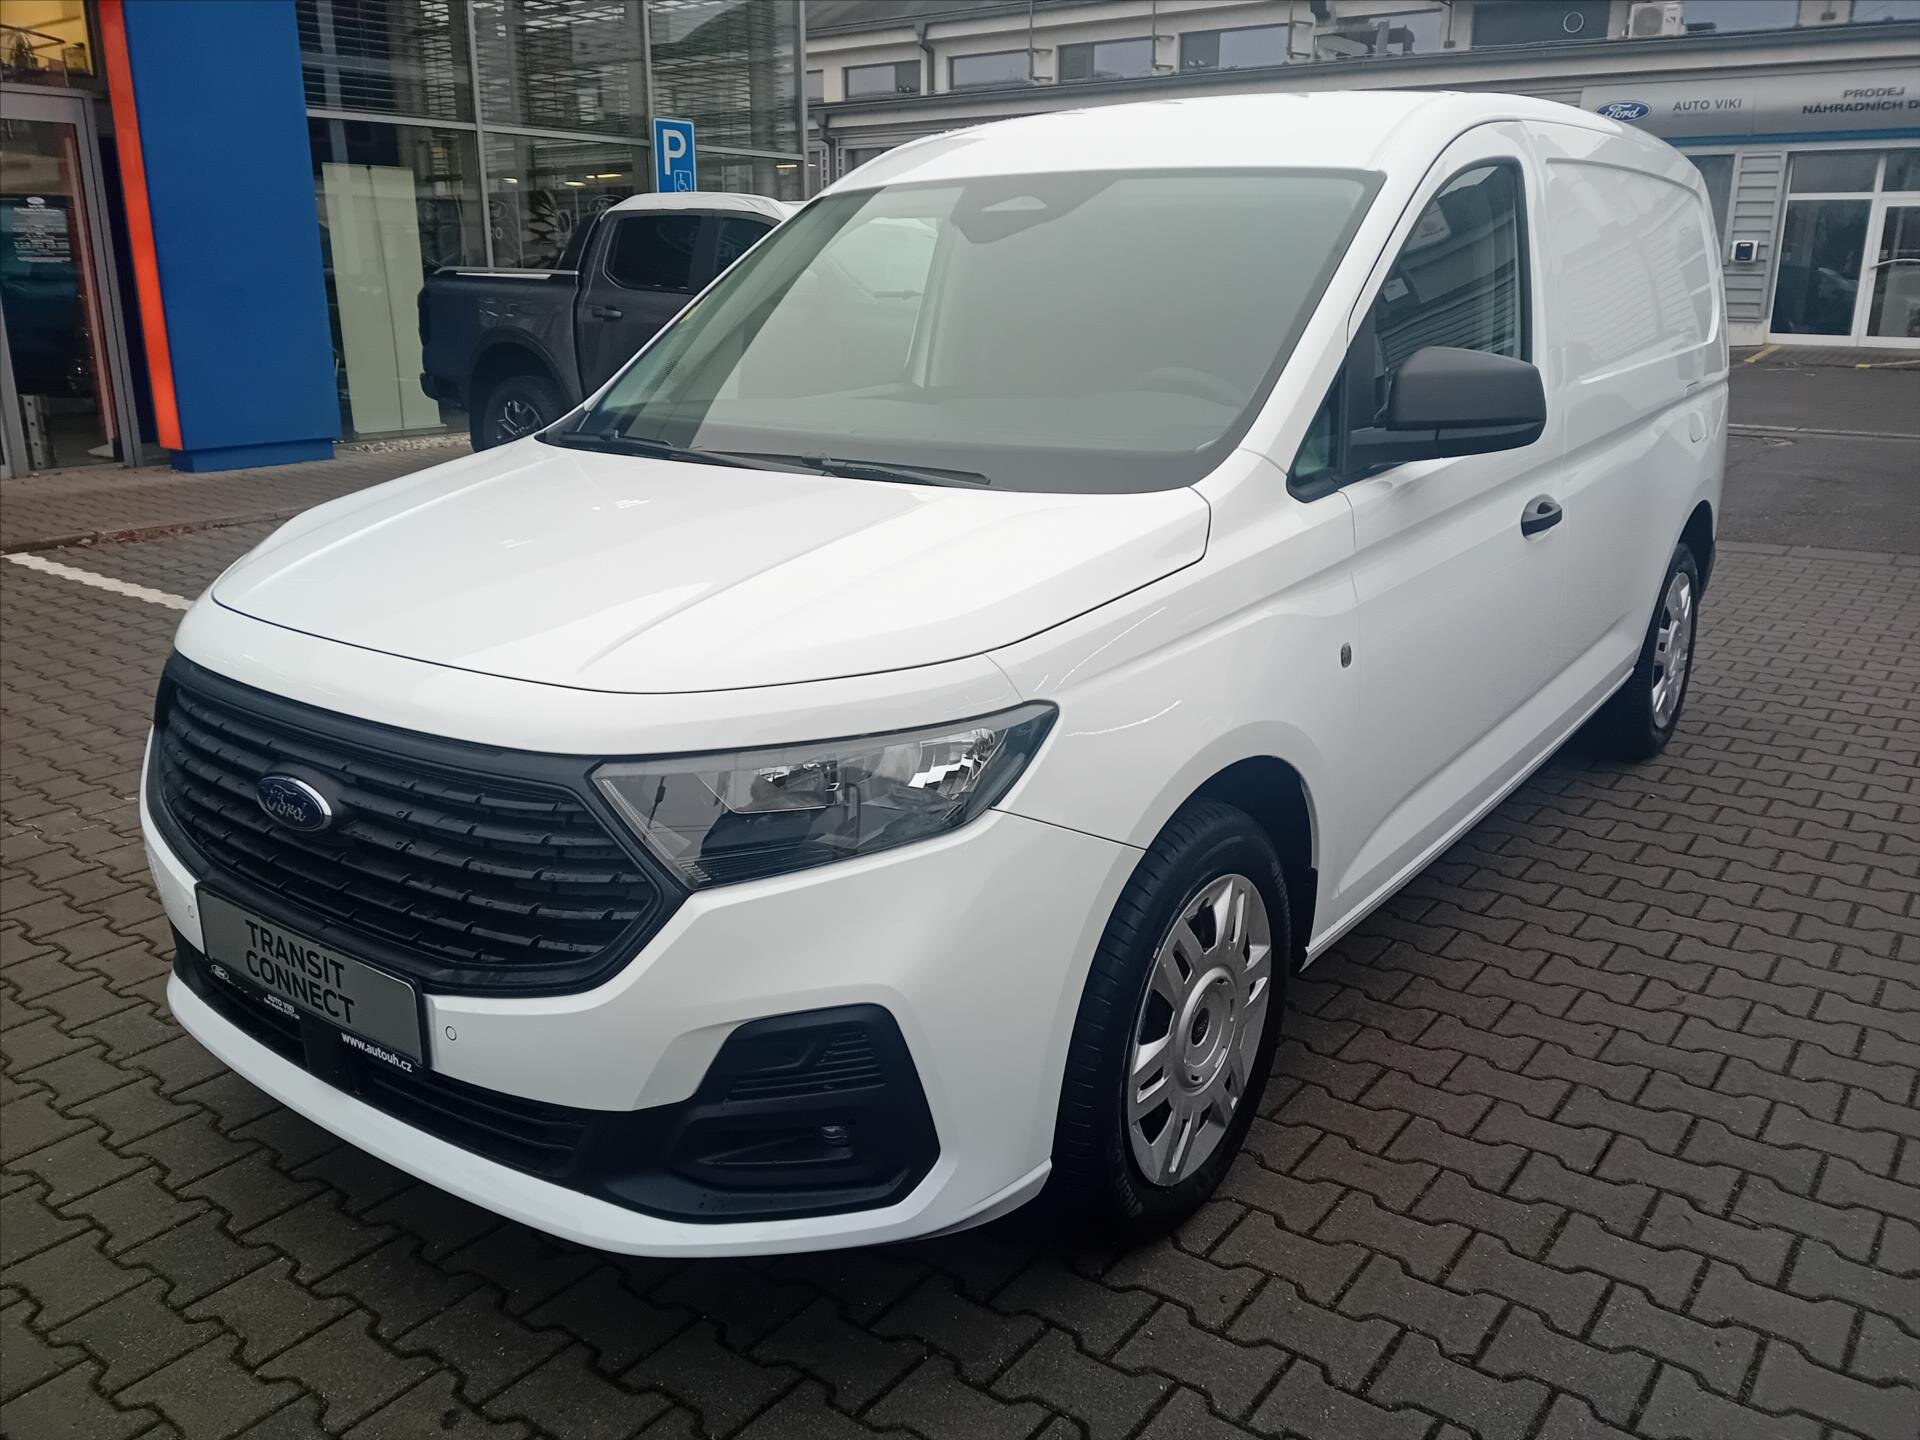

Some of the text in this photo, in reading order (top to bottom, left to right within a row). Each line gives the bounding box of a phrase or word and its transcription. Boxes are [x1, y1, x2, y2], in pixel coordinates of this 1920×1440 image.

[1672, 98, 1743, 112] AUTO VIKI
[1802, 99, 1903, 114] NÁHRADNÍCH
[1843, 87, 1905, 99] PRODEJ
[1605, 103, 1640, 119] Ford
[662, 129, 687, 176] P
[244, 919, 345, 989] TRANSIT
[246, 950, 355, 1024] CONNECT
[341, 1032, 413, 1073] www.autouh.cz
